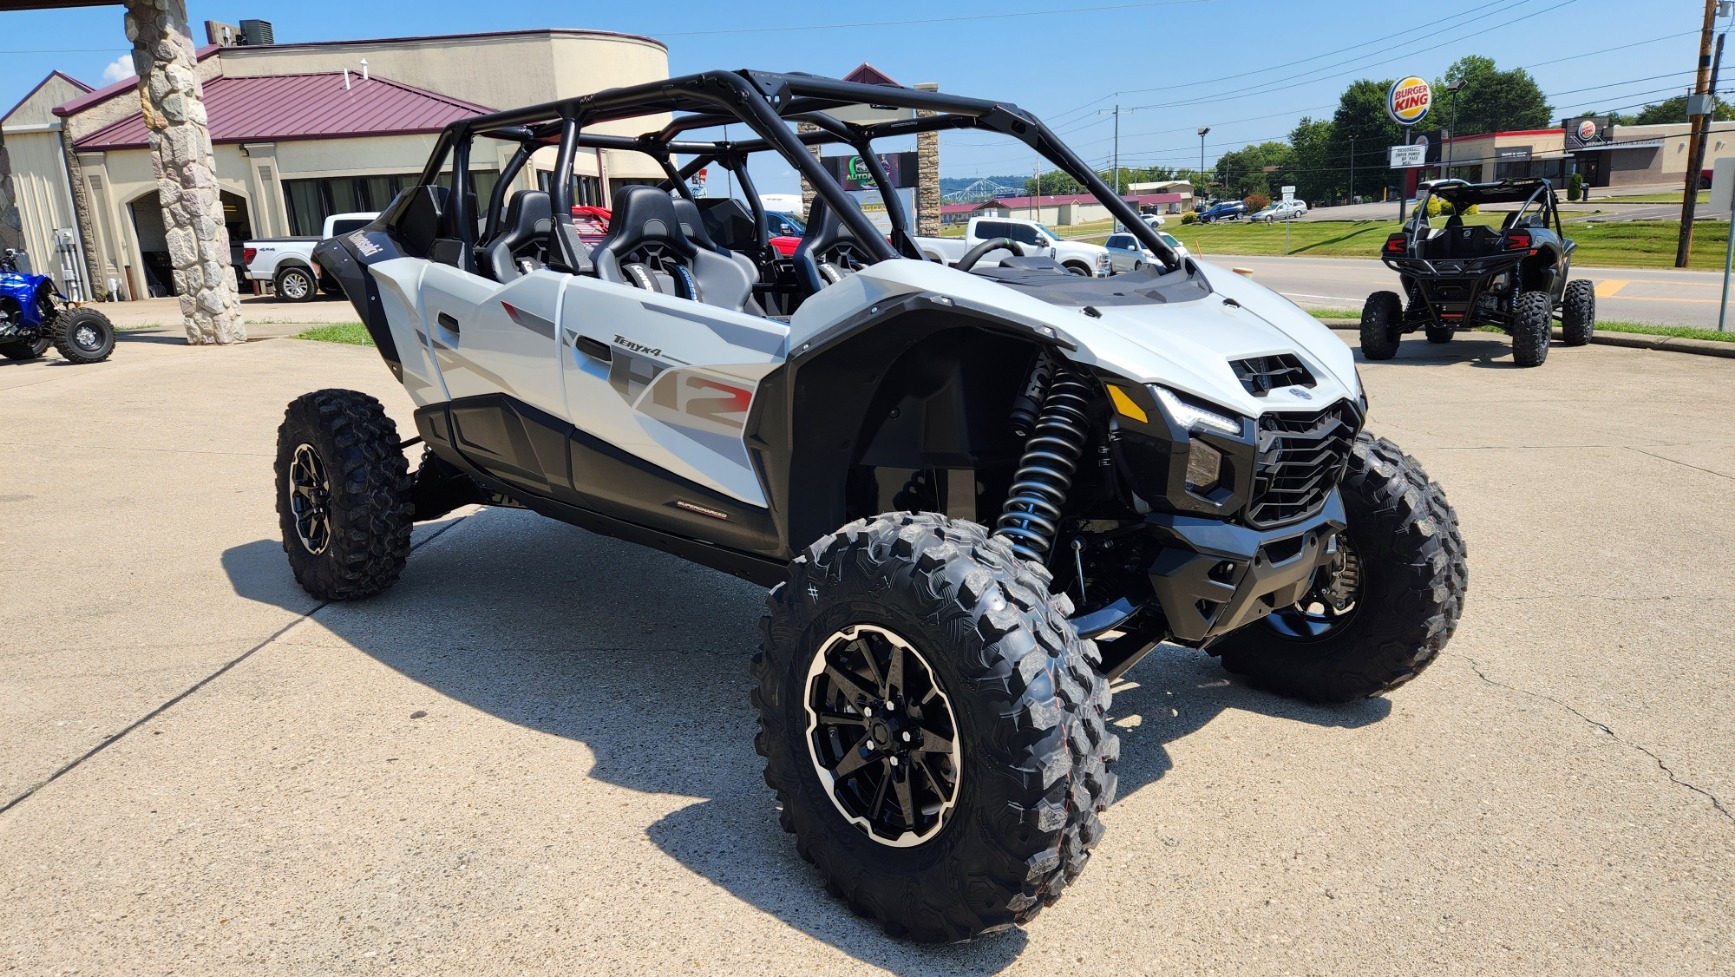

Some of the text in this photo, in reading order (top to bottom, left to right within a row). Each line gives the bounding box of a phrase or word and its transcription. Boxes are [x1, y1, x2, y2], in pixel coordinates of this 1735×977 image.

[1395, 85, 1428, 100] BURGER
[1395, 94, 1428, 112] KING
[608, 351, 753, 429] H2
[1025, 351, 1053, 402] FOX
